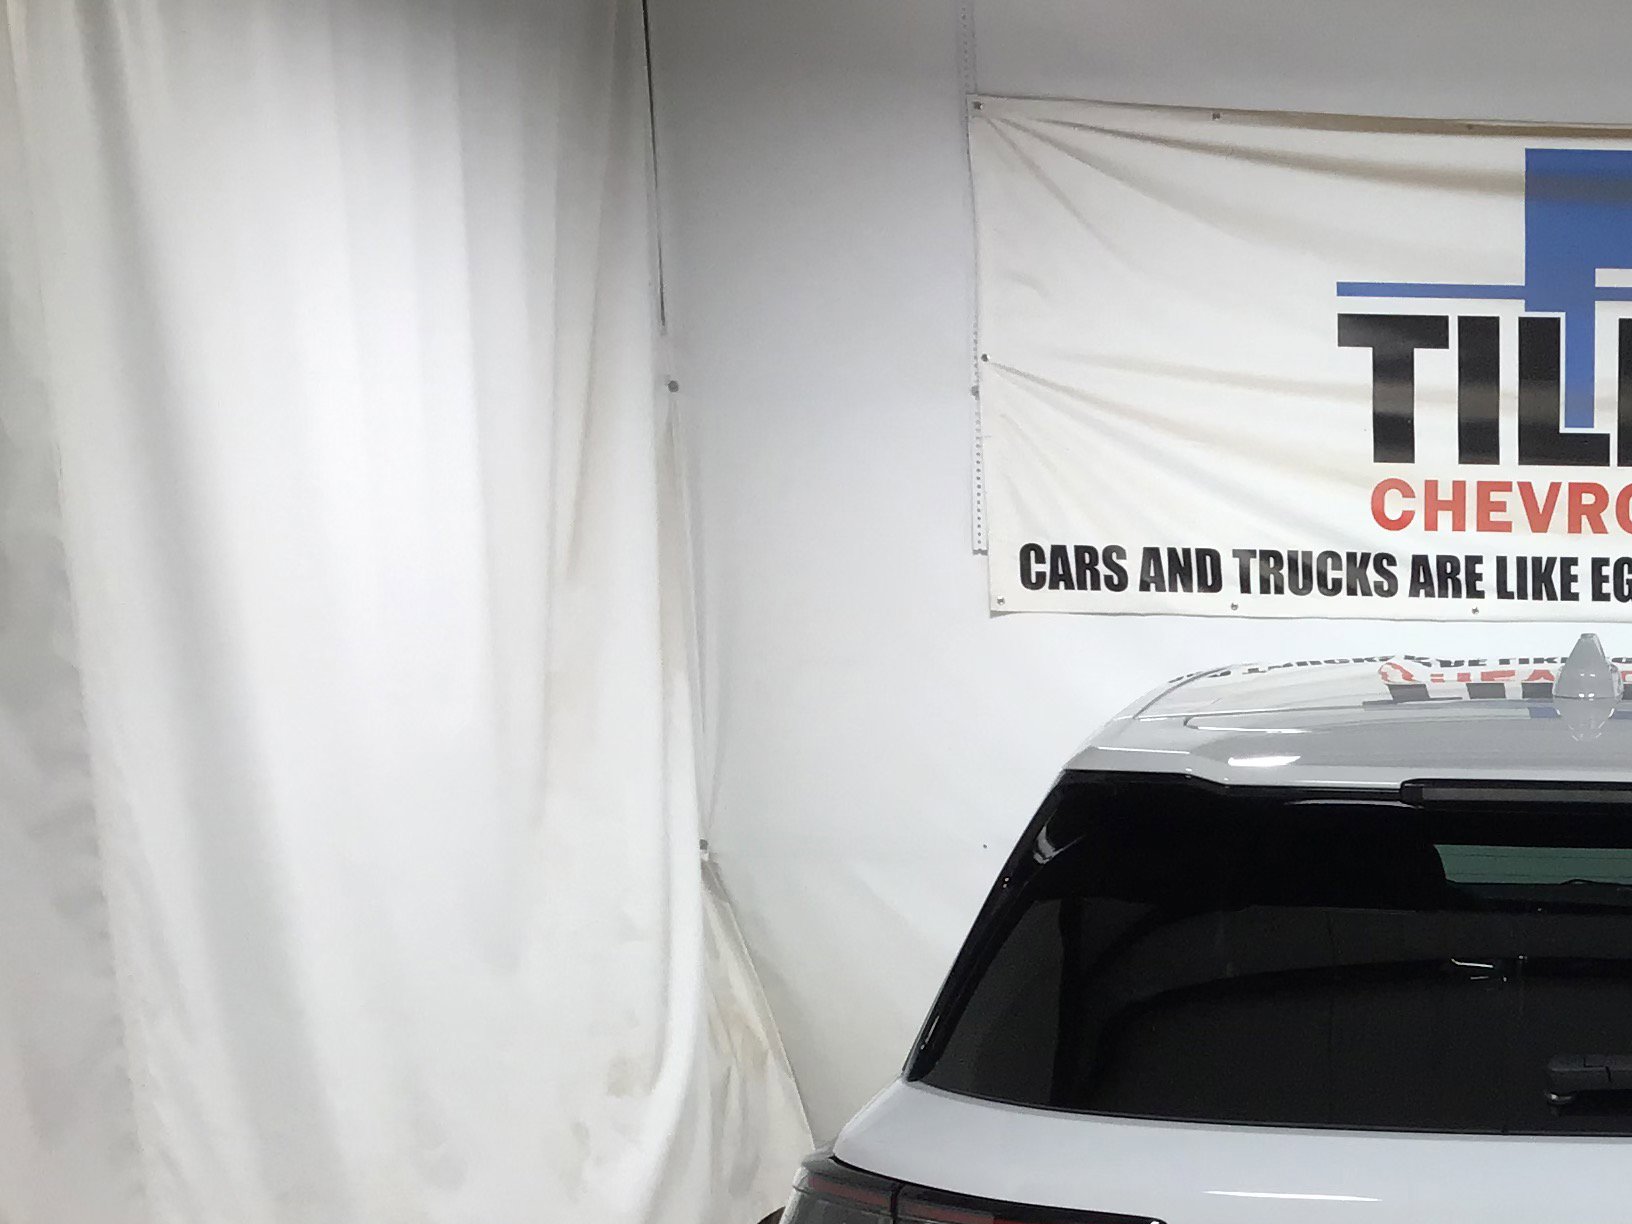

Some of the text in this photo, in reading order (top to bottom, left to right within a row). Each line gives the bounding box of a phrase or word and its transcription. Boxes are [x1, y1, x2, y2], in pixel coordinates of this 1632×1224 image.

[1018, 541, 1129, 593] CARS
[1138, 546, 1224, 594] AND
[1232, 548, 1398, 597] TRUCKS
[1407, 553, 1486, 600] ARE
[1495, 554, 1580, 602] LIKE
